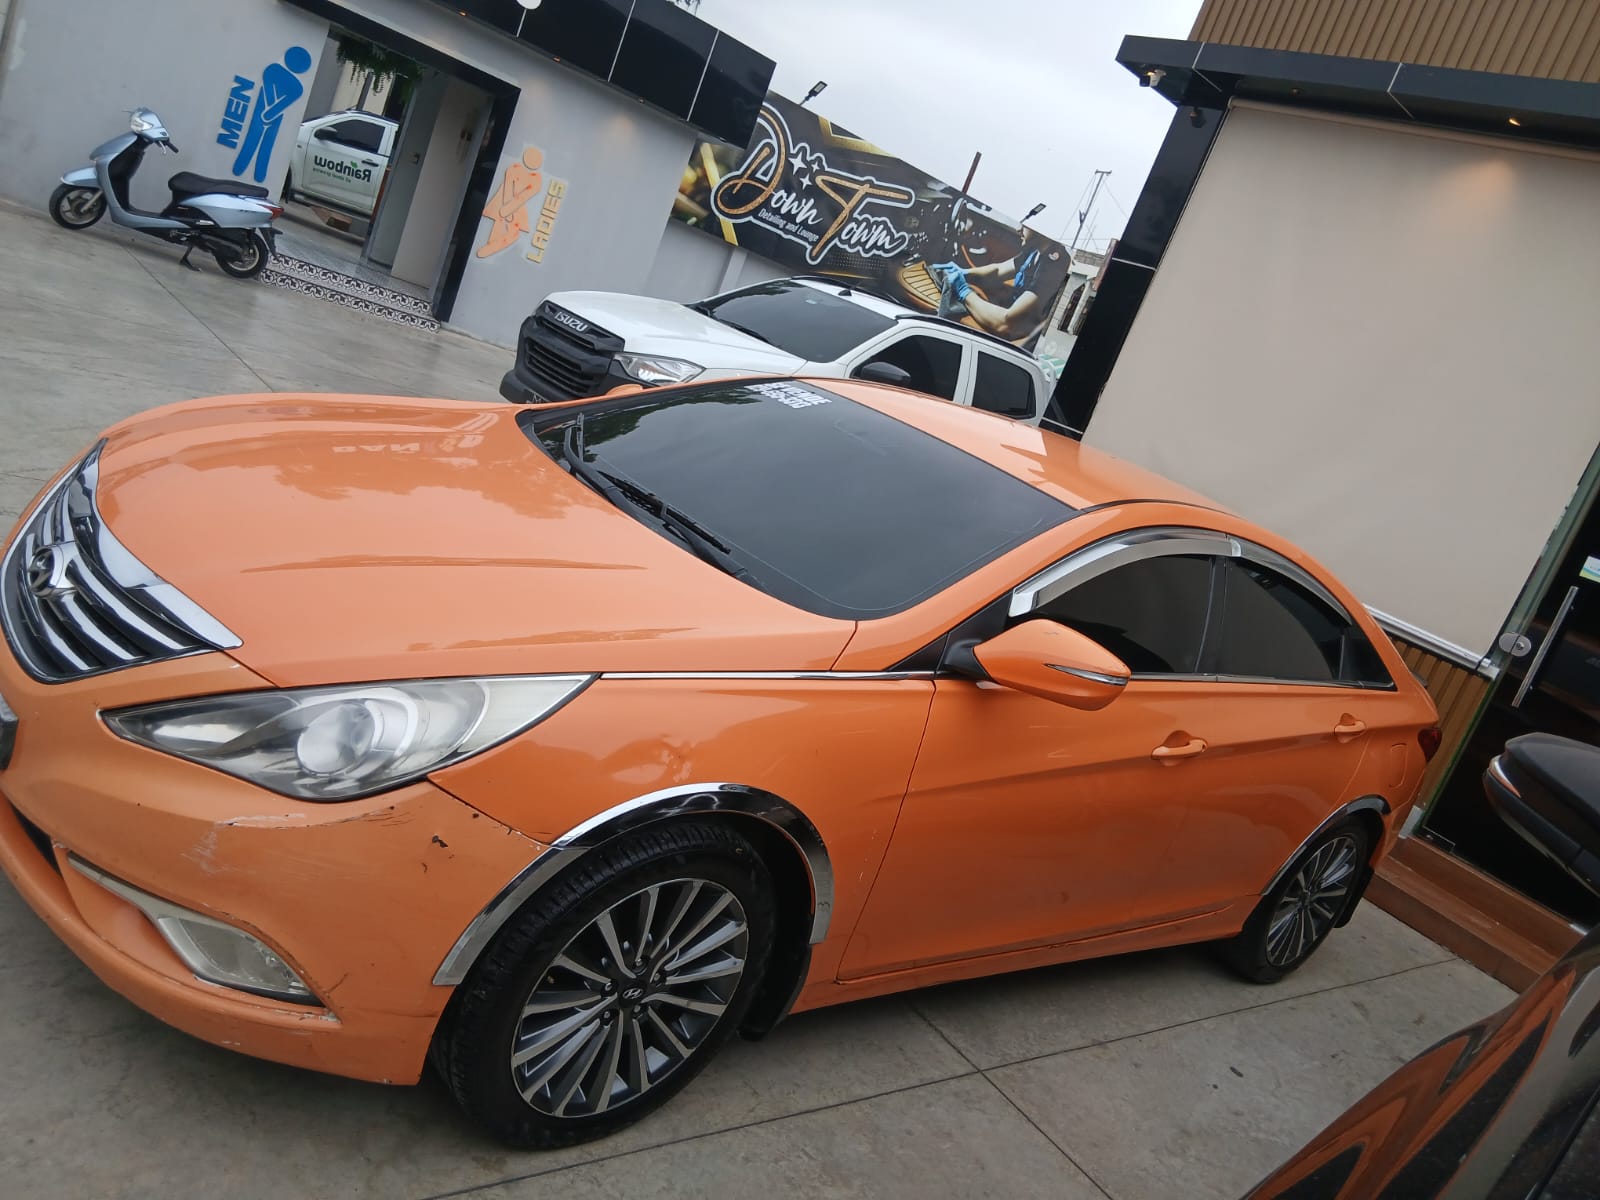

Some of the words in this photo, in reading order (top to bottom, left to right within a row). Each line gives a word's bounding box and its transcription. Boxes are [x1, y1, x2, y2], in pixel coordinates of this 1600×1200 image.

[216, 75, 255, 150] MEN
[526, 179, 568, 264] LADIES
[554, 311, 588, 332] ISUZU
